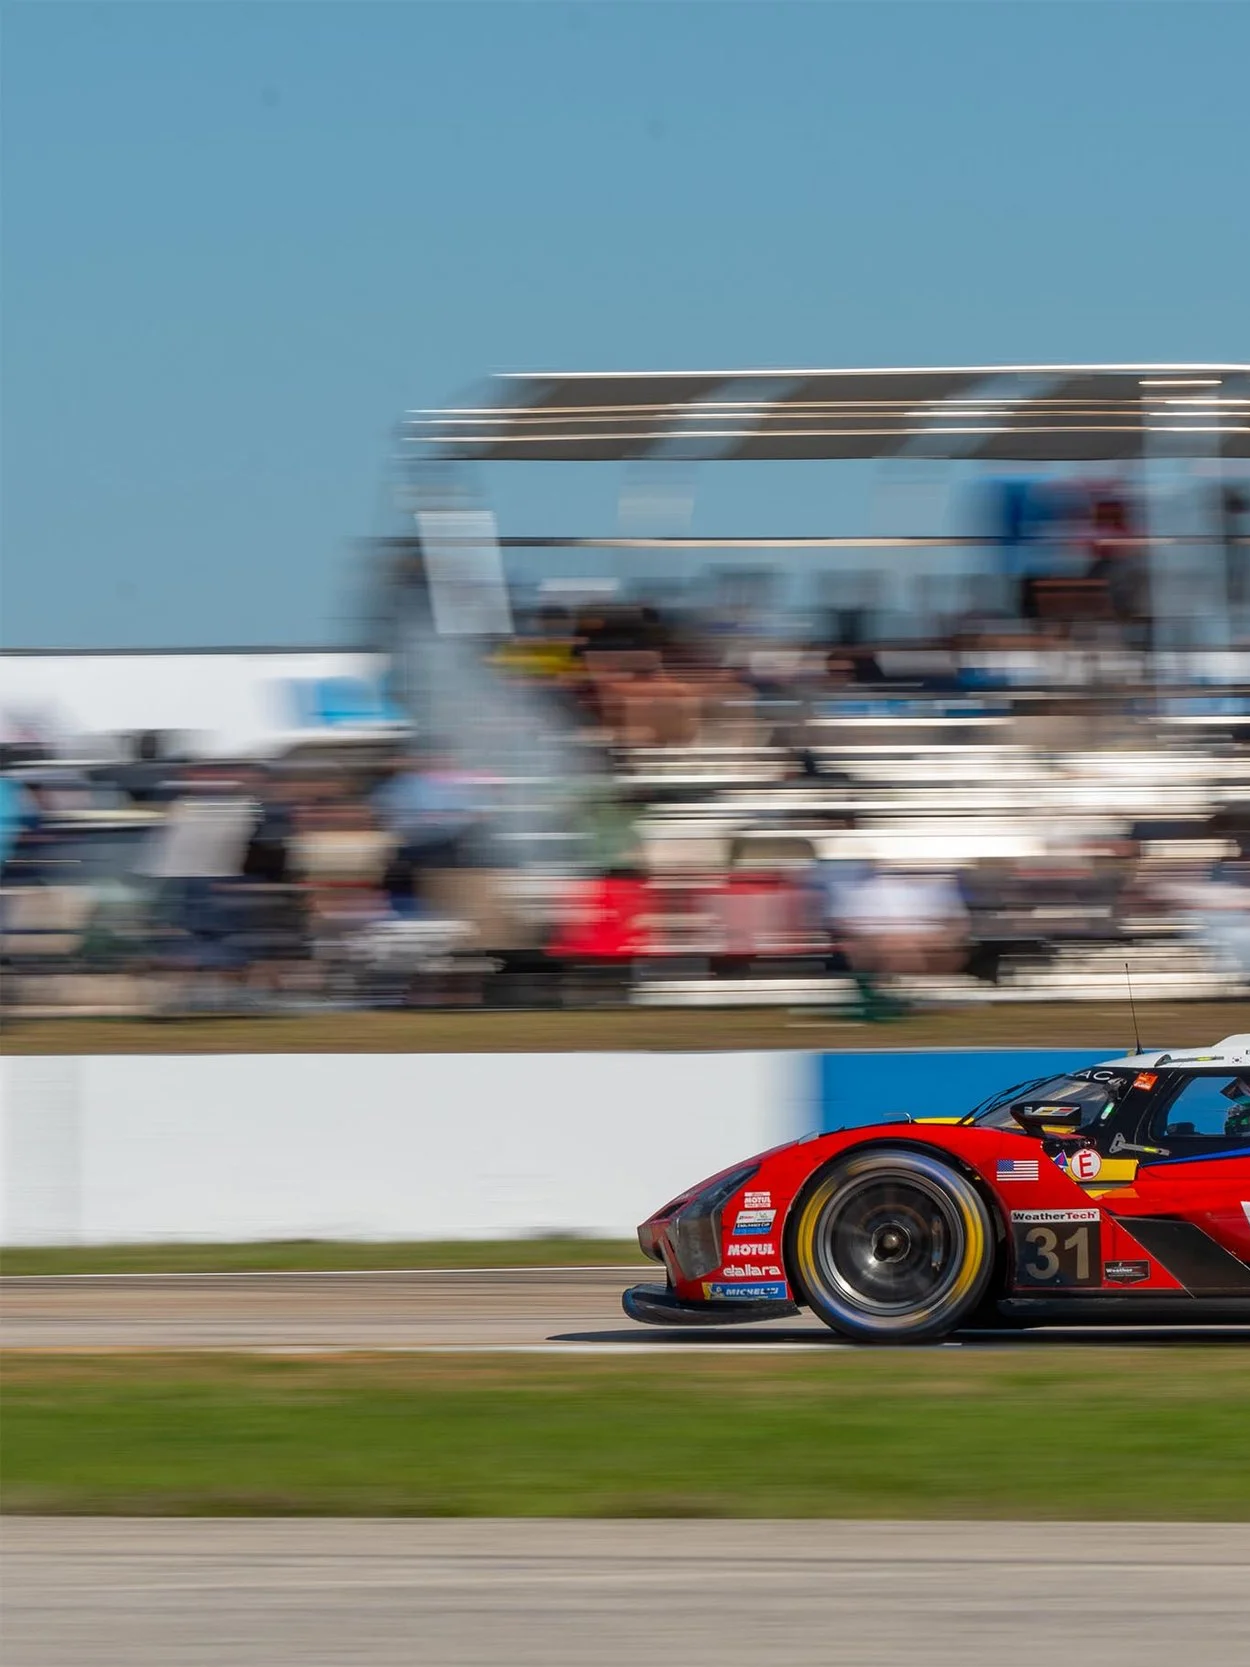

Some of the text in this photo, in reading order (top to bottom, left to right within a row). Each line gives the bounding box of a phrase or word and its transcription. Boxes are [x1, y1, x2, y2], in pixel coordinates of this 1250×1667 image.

[1072, 1070, 1114, 1081] AC
[1013, 1211, 1096, 1221] WeatherTech
[727, 1243, 775, 1256] MOTUL
[1025, 1227, 1089, 1280] 31
[723, 1264, 781, 1277] dallara
